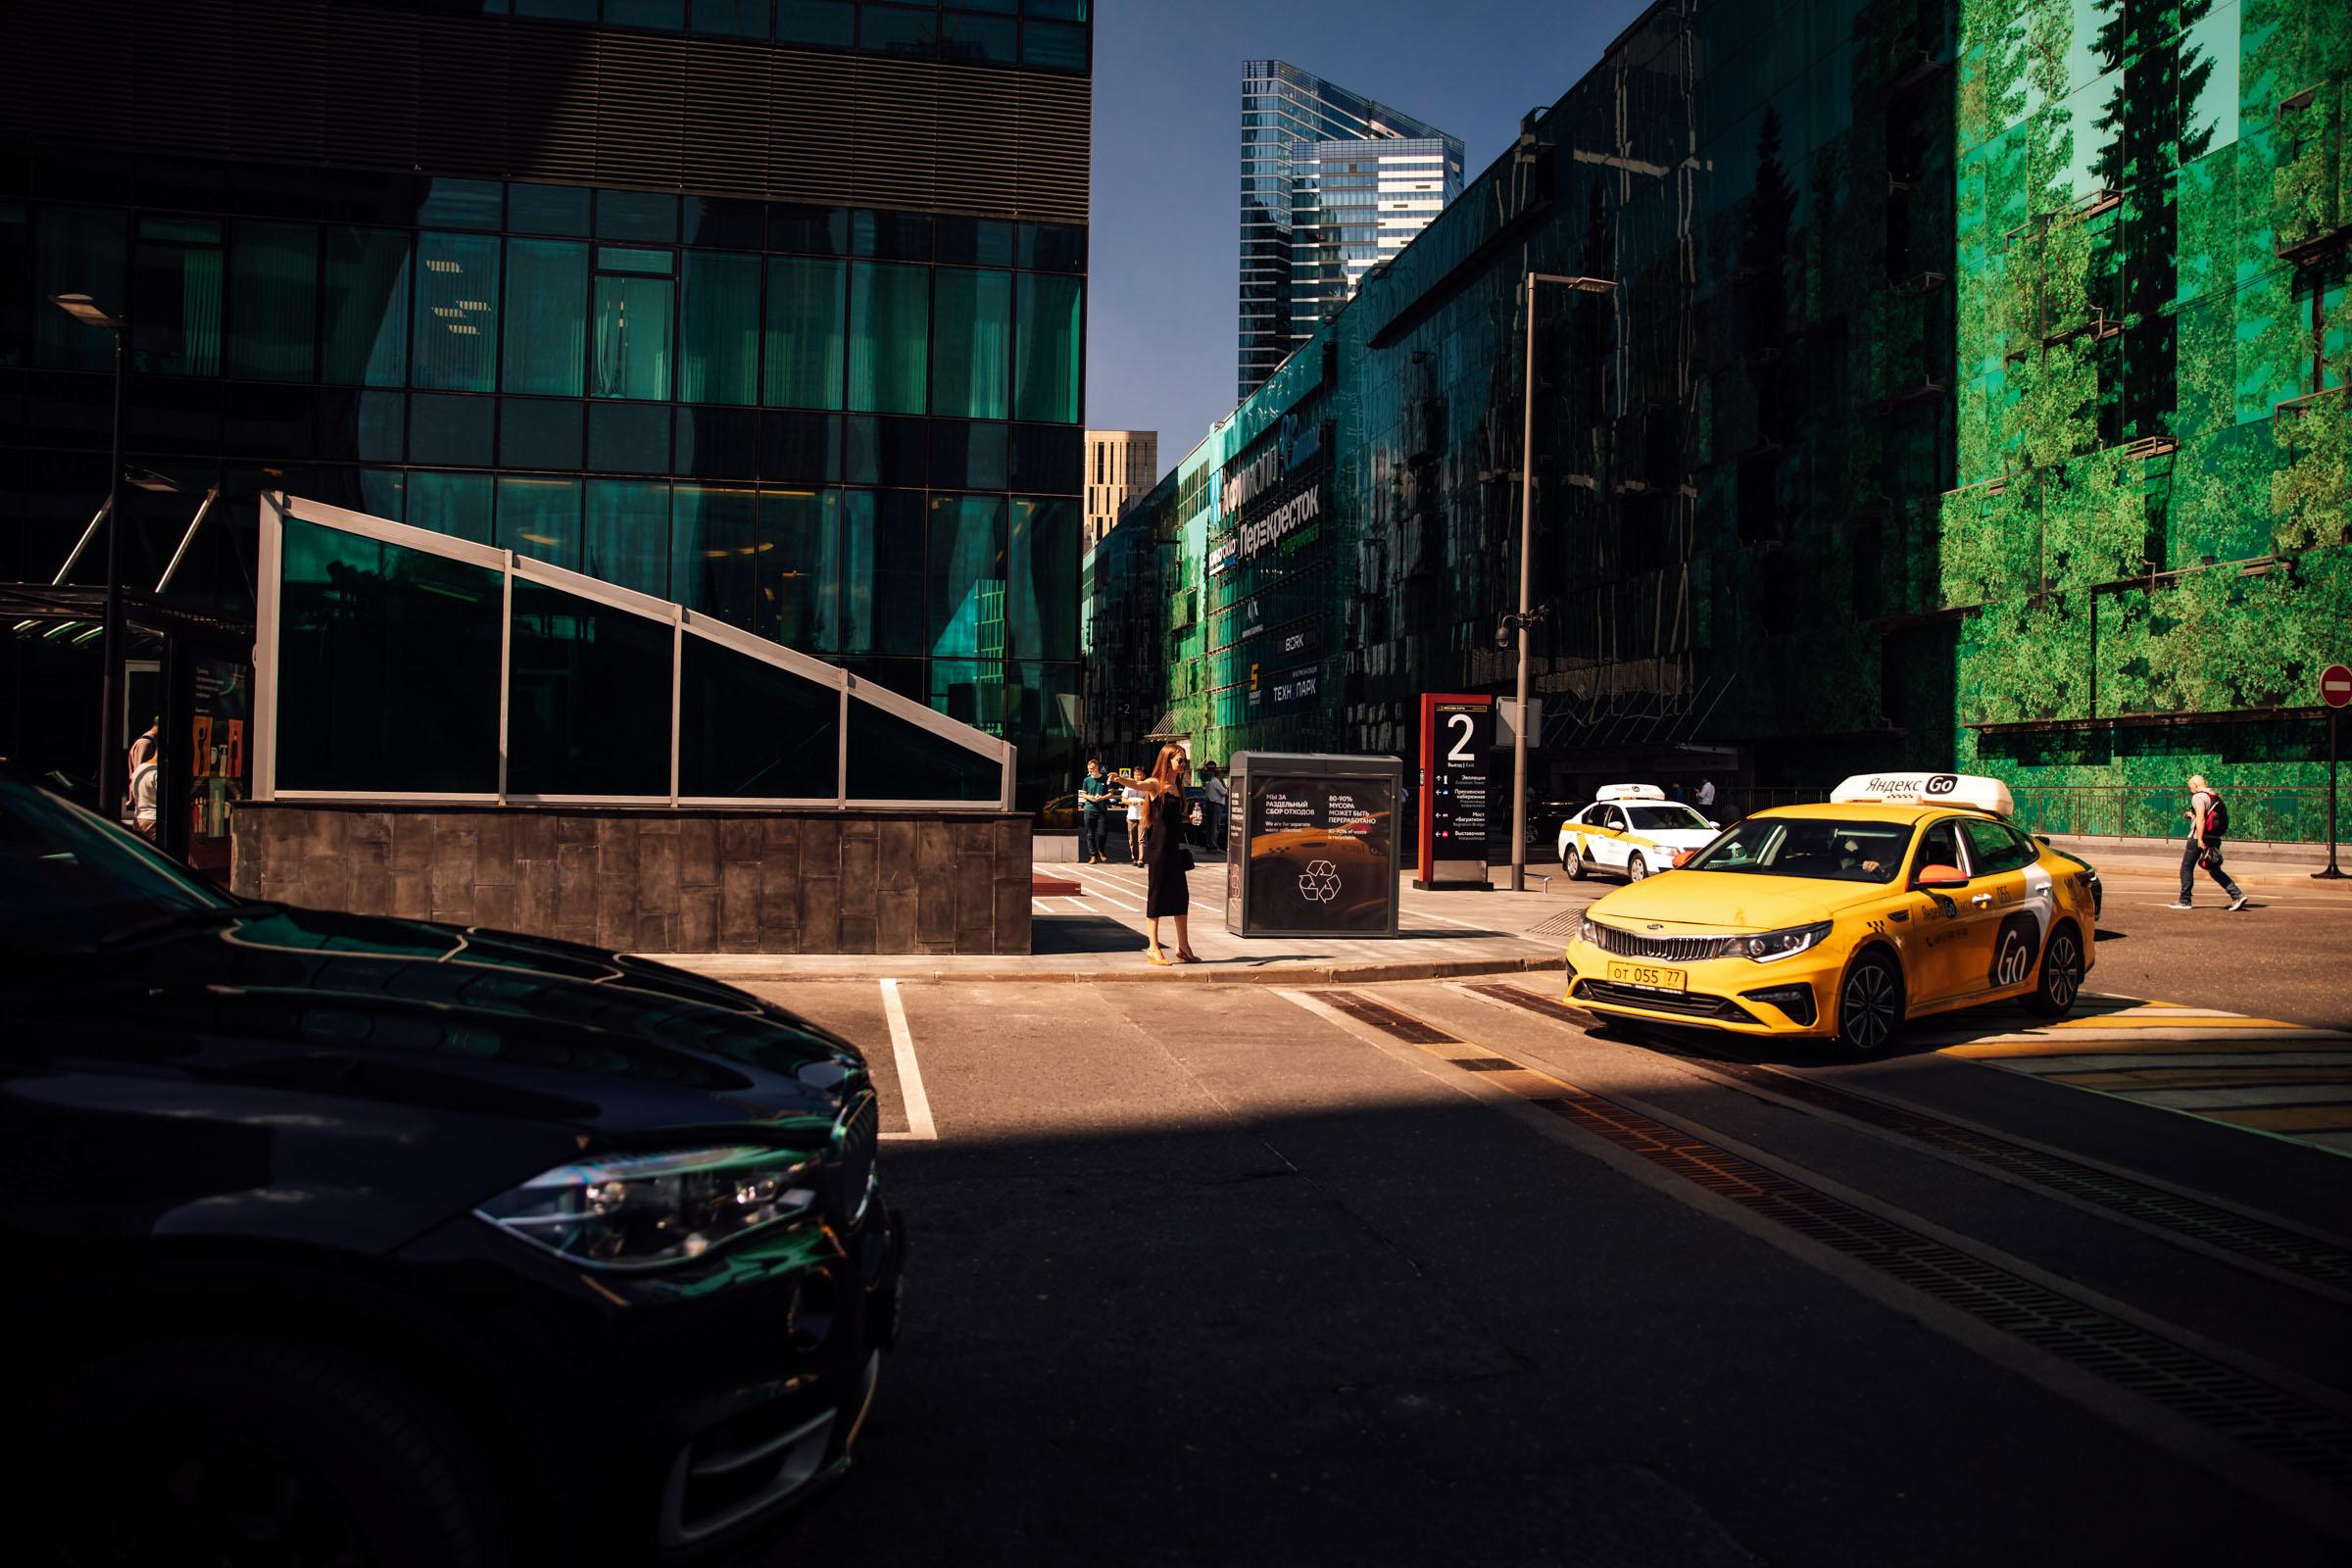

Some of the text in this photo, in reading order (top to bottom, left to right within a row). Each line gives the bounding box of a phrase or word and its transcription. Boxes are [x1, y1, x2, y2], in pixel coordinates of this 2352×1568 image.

[1285, 633, 1304, 652] BORK
[1447, 713, 1475, 760] 2
[1865, 776, 1954, 793] Яндекс Go
[1997, 929, 2027, 986] Go
[1614, 967, 1680, 984] ОТ 055 77
